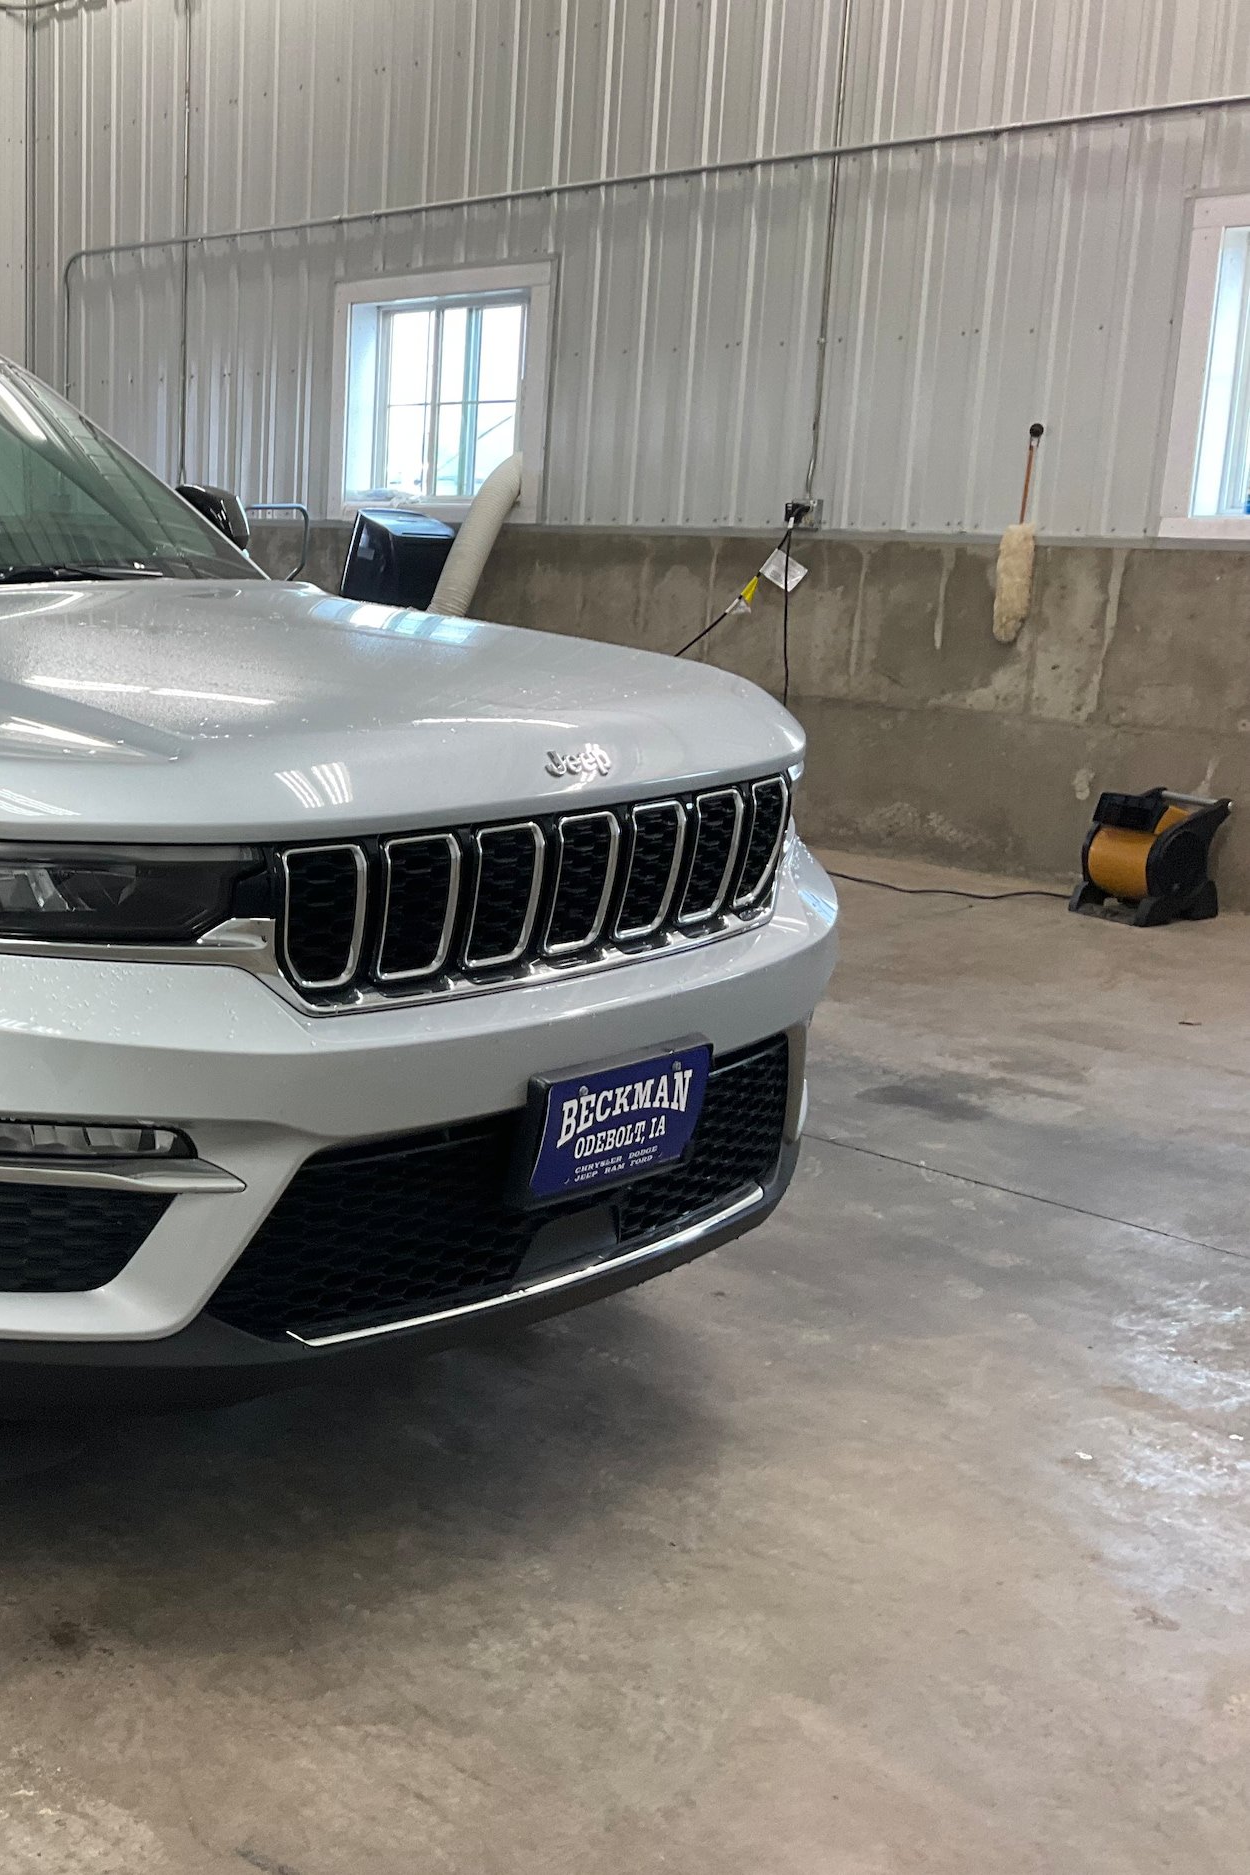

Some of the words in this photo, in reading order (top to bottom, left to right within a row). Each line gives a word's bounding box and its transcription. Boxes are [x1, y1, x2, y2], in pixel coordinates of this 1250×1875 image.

[545, 743, 611, 778] Jeep
[556, 1069, 693, 1149] BECKMAN
[574, 1121, 646, 1159] ODEBOLT,
[649, 1115, 666, 1139] IA
[574, 1155, 623, 1174] CHRYSLER
[628, 1145, 658, 1160] DODGE
[574, 1170, 598, 1182] JEEP
[604, 1162, 625, 1175] RAM
[630, 1154, 653, 1167] FORD
